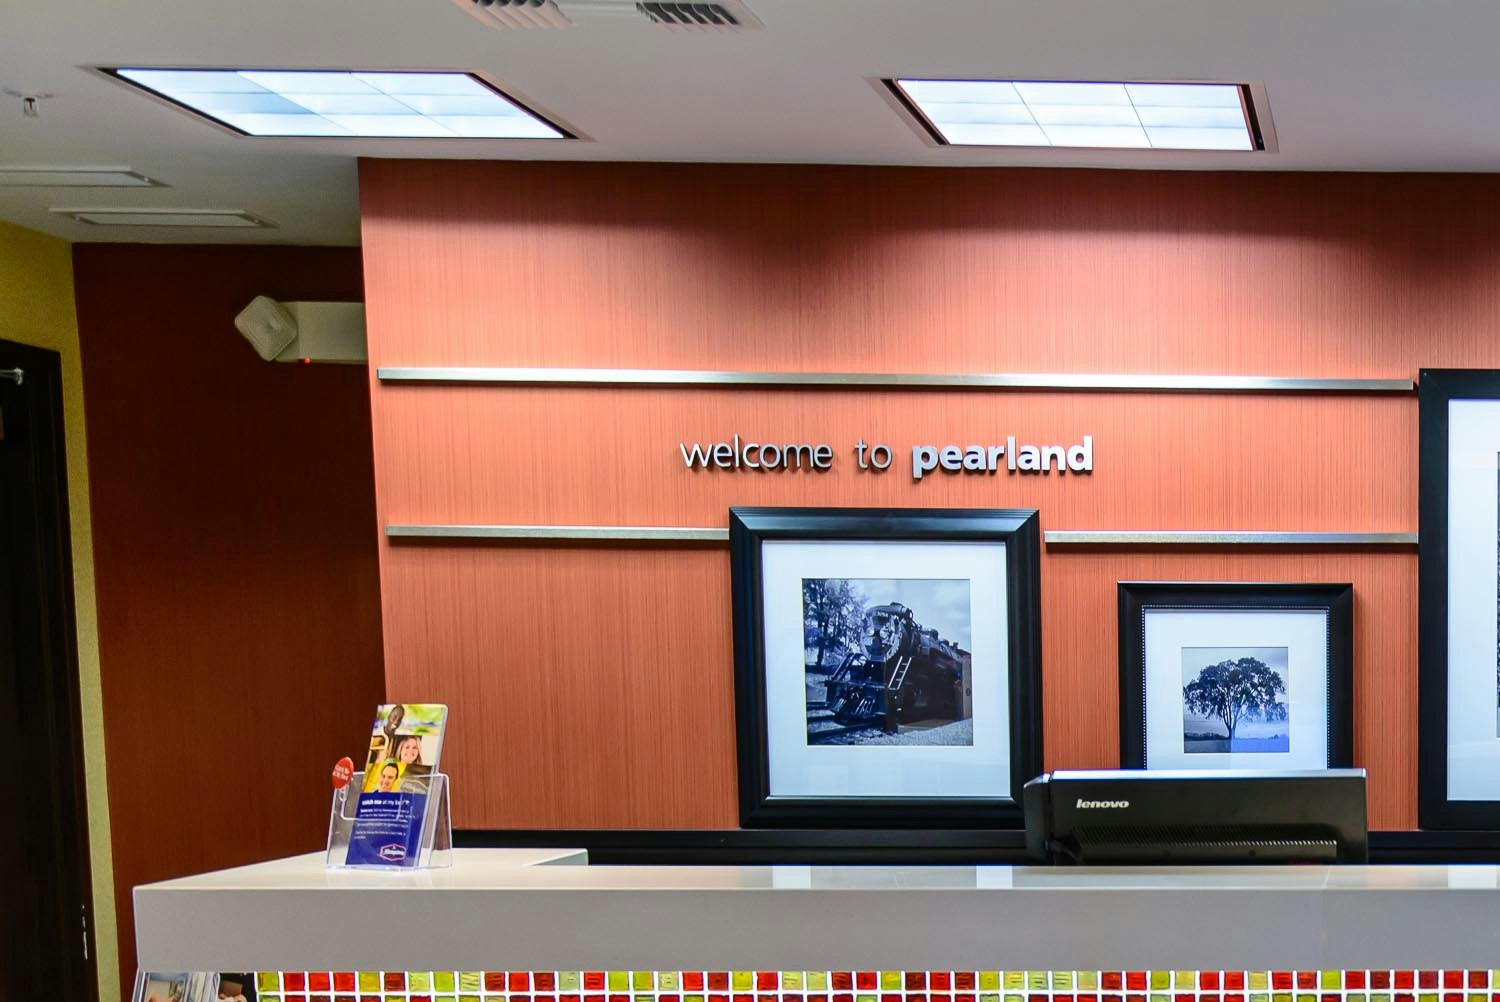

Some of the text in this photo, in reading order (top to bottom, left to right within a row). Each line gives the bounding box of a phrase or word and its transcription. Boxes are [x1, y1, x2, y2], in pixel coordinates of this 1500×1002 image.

[679, 434, 1093, 479] welcome to pearland
[1076, 798, 1130, 809] lenovo
